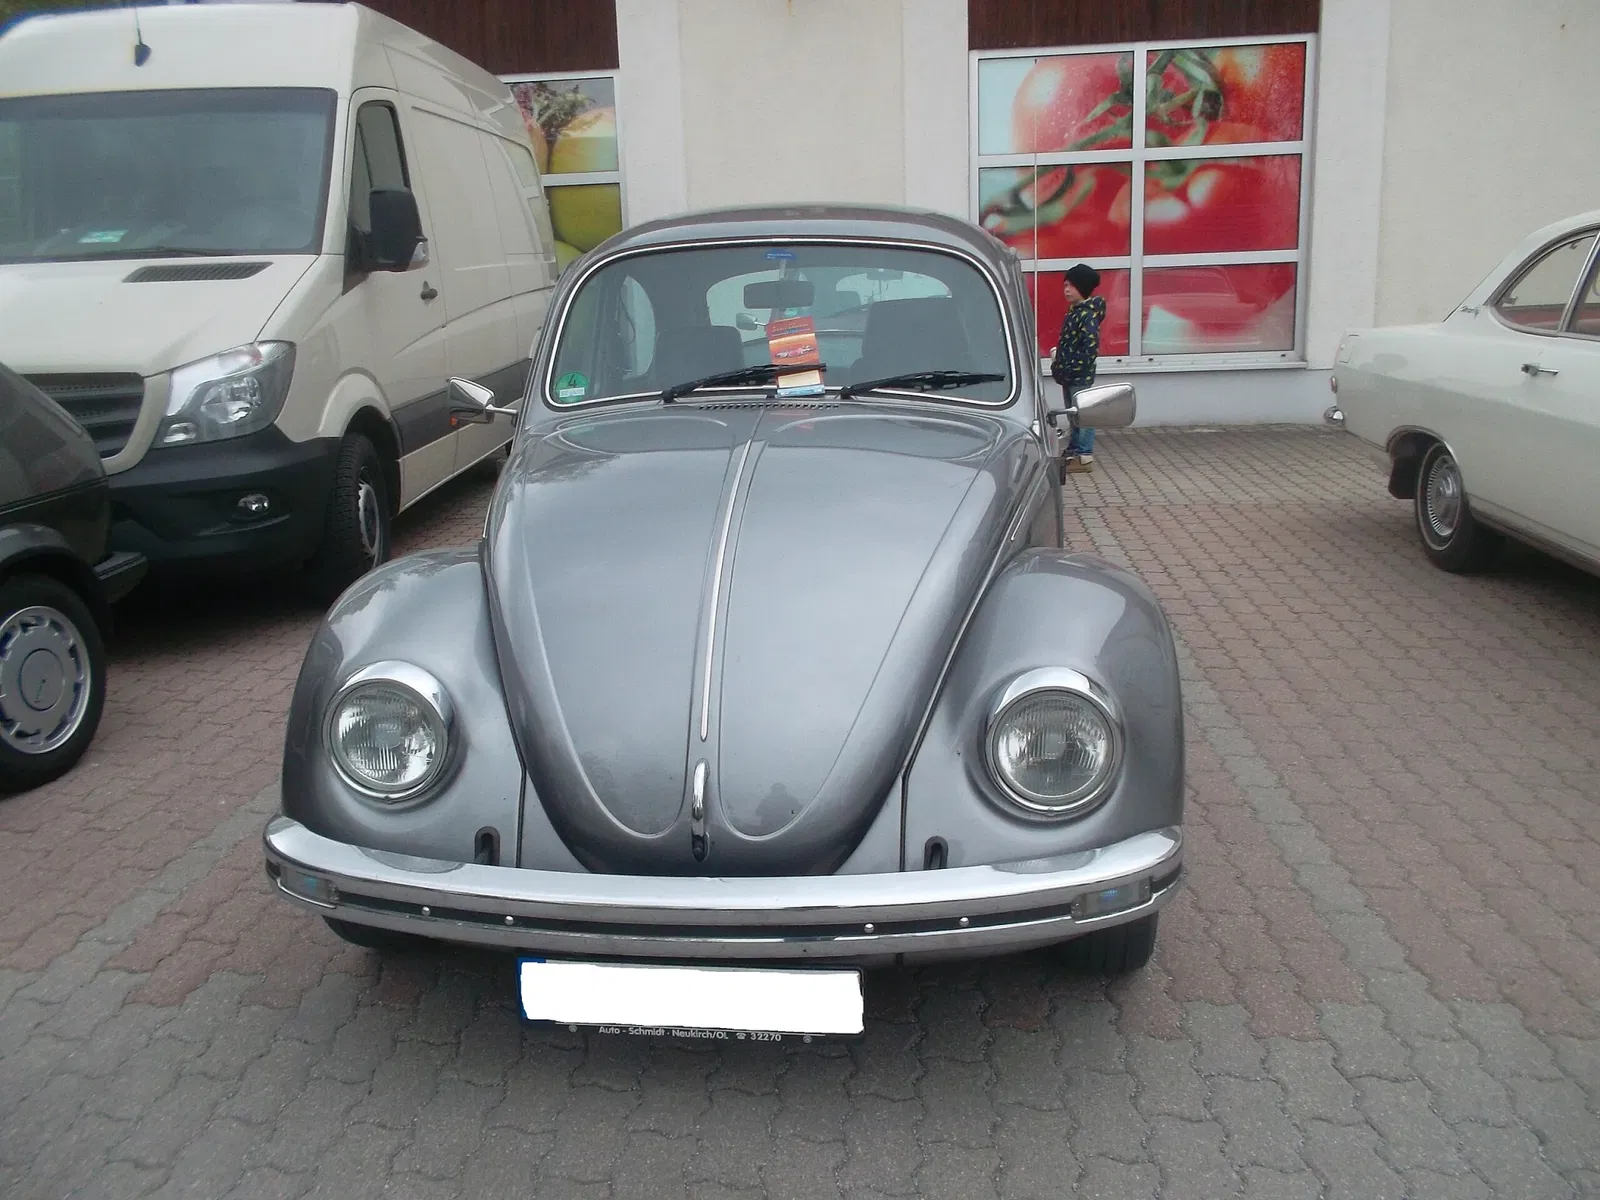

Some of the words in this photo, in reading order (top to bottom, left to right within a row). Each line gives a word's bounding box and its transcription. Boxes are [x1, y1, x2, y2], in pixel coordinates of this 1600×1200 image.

[567, 373, 578, 389] 4
[598, 1025, 621, 1035] Auto
[629, 1026, 665, 1036] Schmidt
[750, 1031, 781, 1042] 32270
